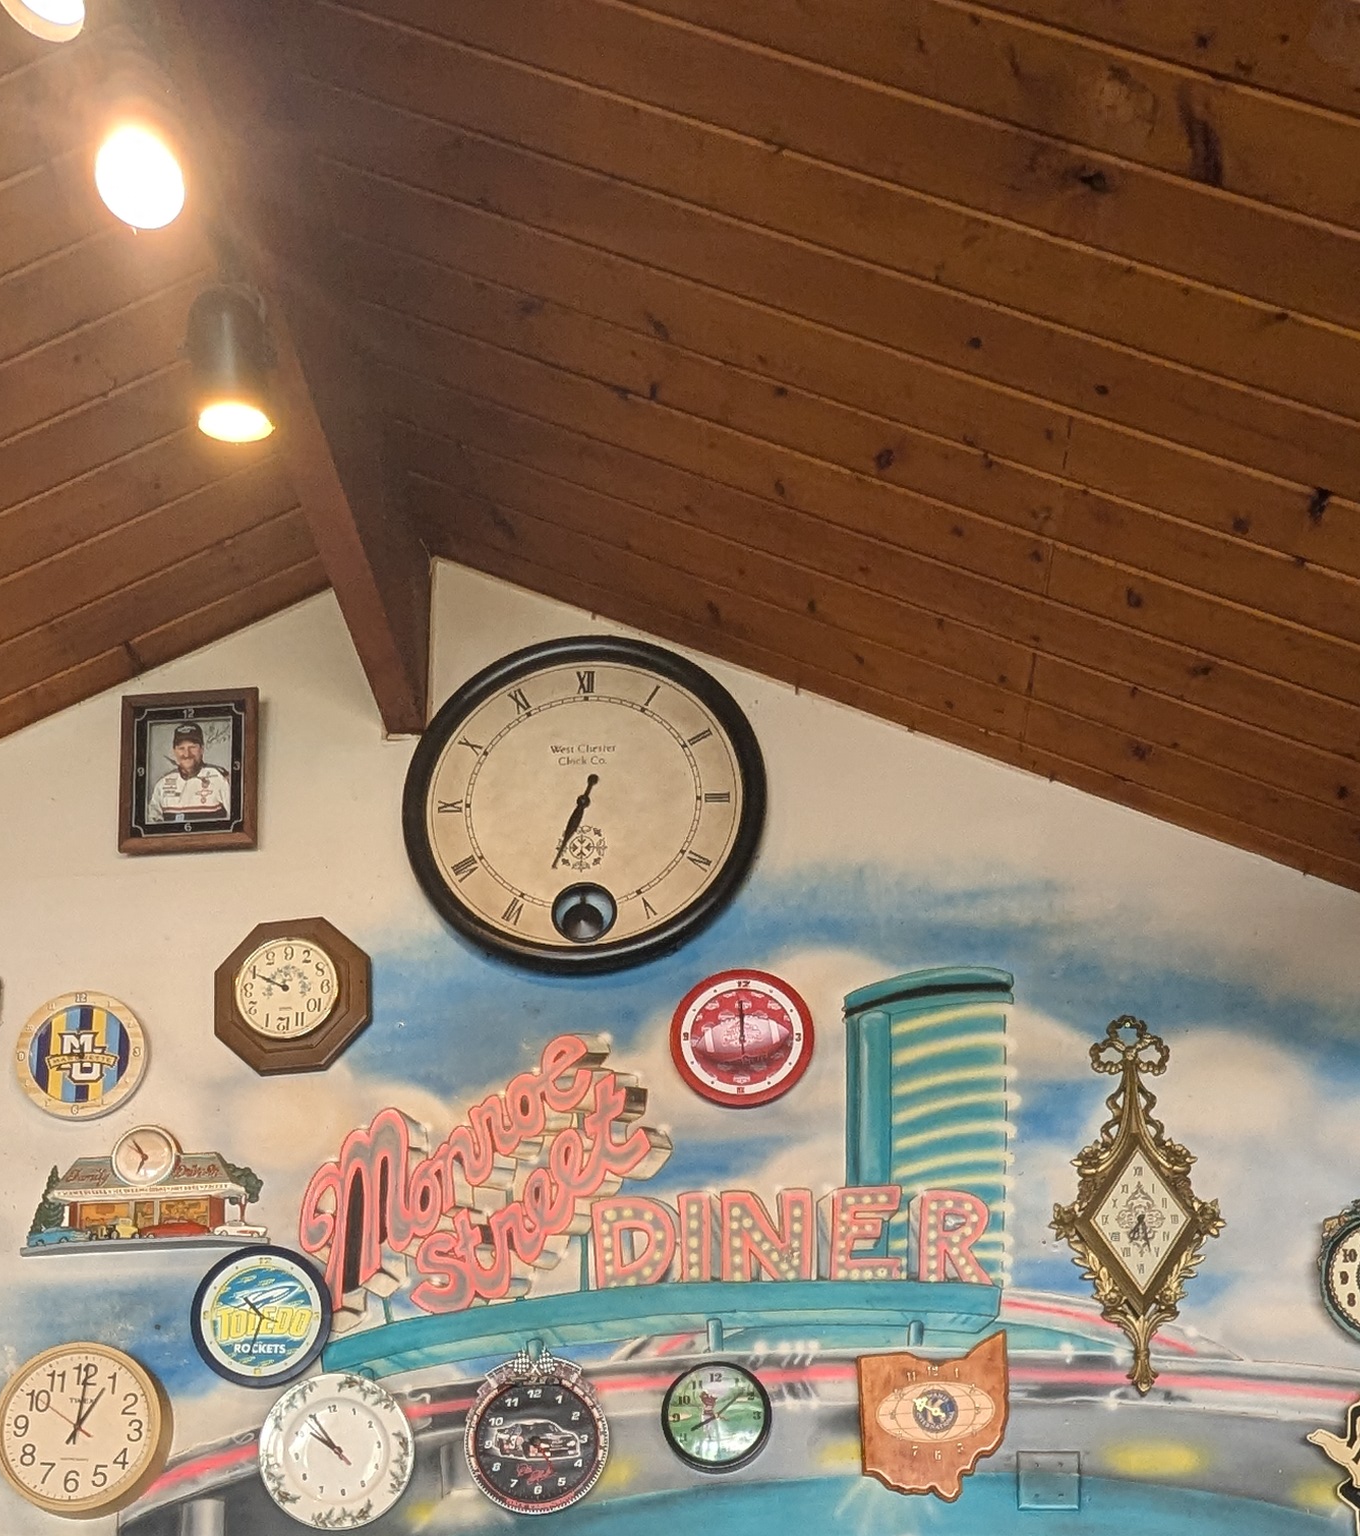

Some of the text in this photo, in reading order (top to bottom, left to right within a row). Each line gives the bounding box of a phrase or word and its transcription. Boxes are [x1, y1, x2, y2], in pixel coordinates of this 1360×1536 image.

[576, 671, 595, 694] XII
[507, 688, 531, 710] XI
[458, 737, 483, 756] X
[688, 728, 713, 745] II
[438, 799, 463, 814] IX
[704, 791, 730, 804] III
[184, 823, 192, 831] 6
[641, 897, 658, 920] V
[75, 993, 87, 1003] 12
[51, 1055, 113, 1064] MARETTE
[300, 1032, 611, 1312] Monroe
[409, 1073, 673, 1314] Street
[591, 1184, 994, 1290] DINER
[1342, 1249, 1357, 1263] 10
[1340, 1271, 1349, 1285] 9
[1347, 1293, 1356, 1307] 8
[216, 1306, 312, 1342] TOLEDO
[233, 1343, 286, 1355] ROCKETS
[47, 1370, 67, 1392] 11
[73, 1363, 98, 1386] 12
[107, 1372, 117, 1395] 1
[709, 1373, 722, 1382] 12
[26, 1389, 51, 1412] 10
[121, 1393, 138, 1415] 2
[505, 1398, 519, 1407] 11
[527, 1390, 542, 1398] 12
[13, 1414, 29, 1437] 9
[489, 1417, 504, 1426] 10
[571, 1412, 580, 1420] 2
[127, 1419, 143, 1442] 3
[20, 1443, 36, 1466] 8
[113, 1448, 129, 1470] 4
[40, 1462, 56, 1484] 7
[64, 1470, 79, 1492] 6
[91, 1464, 108, 1487] 5
